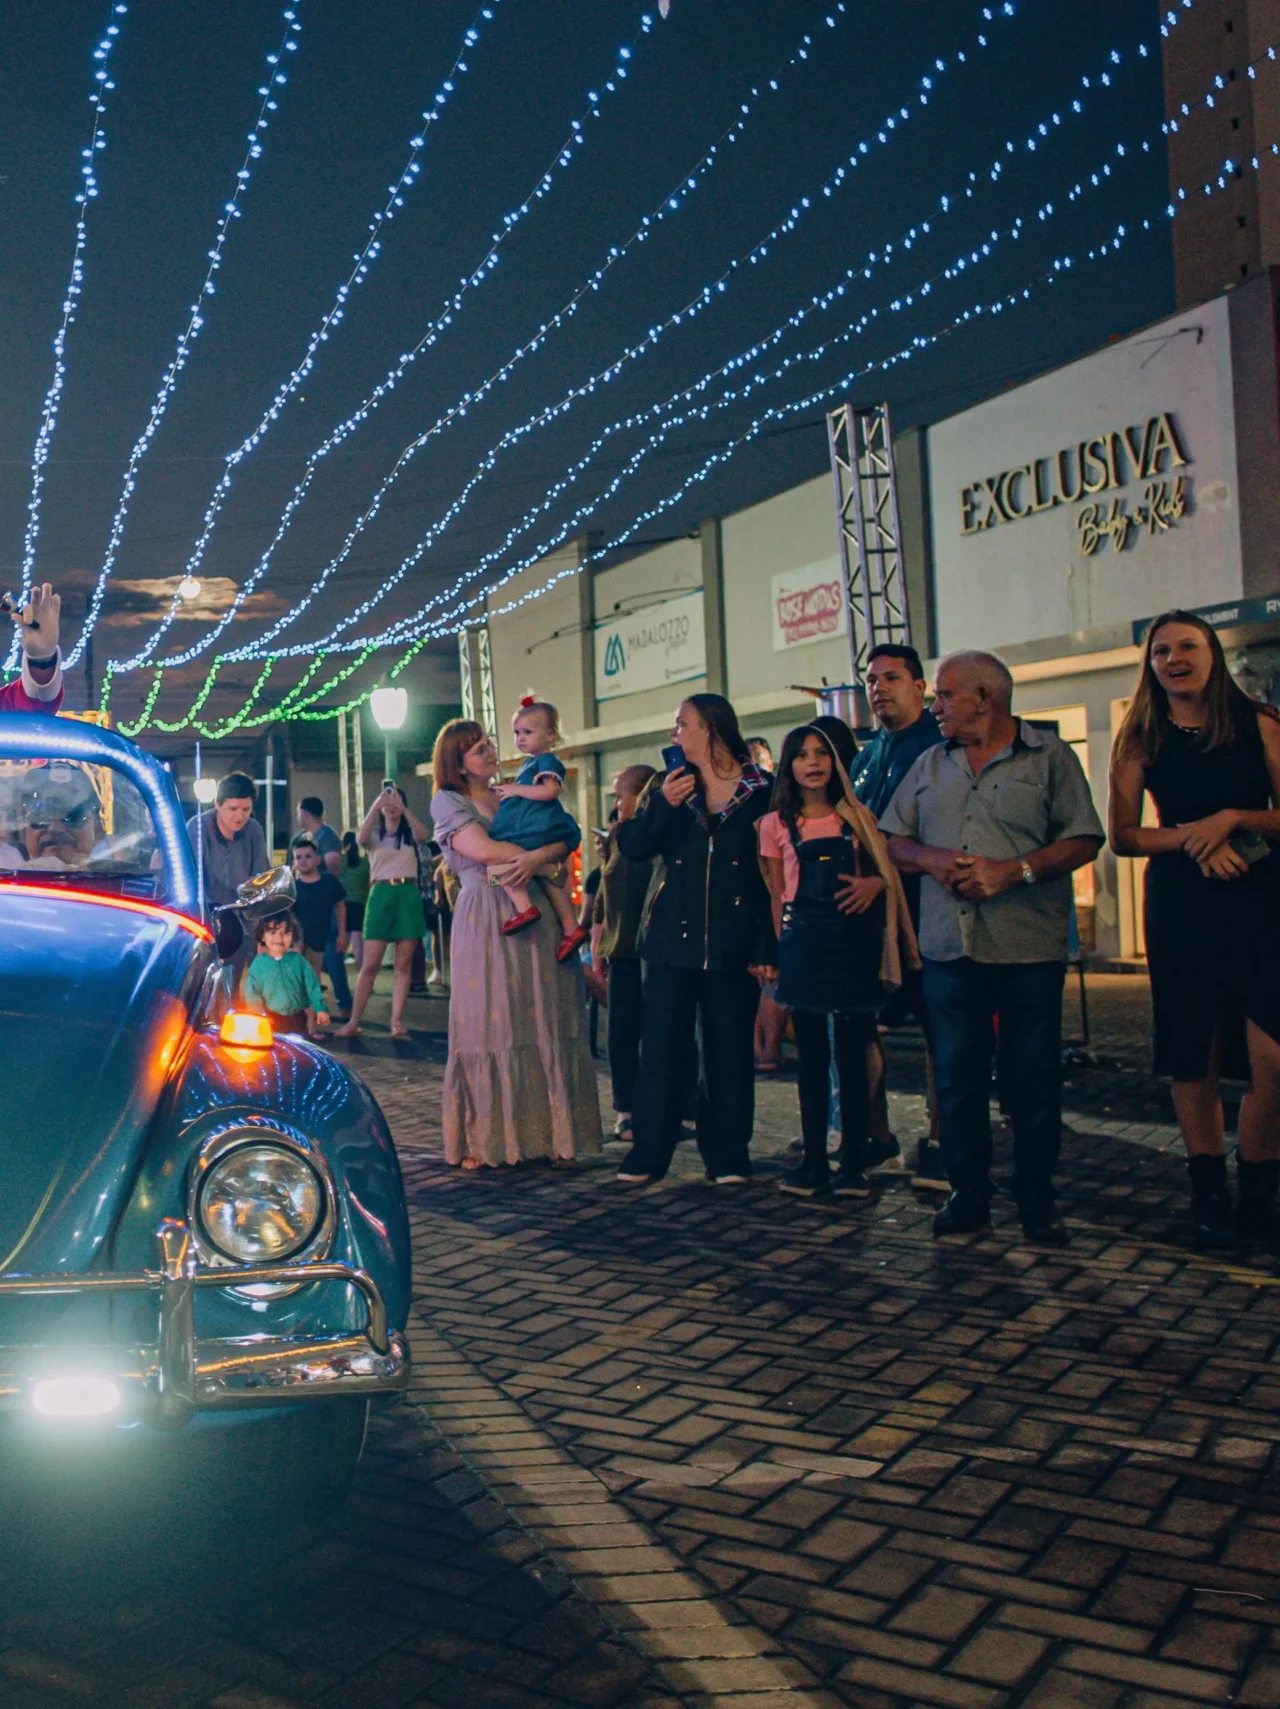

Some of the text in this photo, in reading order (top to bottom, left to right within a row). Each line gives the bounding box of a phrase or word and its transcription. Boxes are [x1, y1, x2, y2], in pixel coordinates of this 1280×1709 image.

[960, 412, 1188, 535] EXCLUSIVA
[1077, 498, 1130, 556] Baby
[1144, 475, 1189, 535] Kids
[627, 615, 690, 654] MADALOZZO
